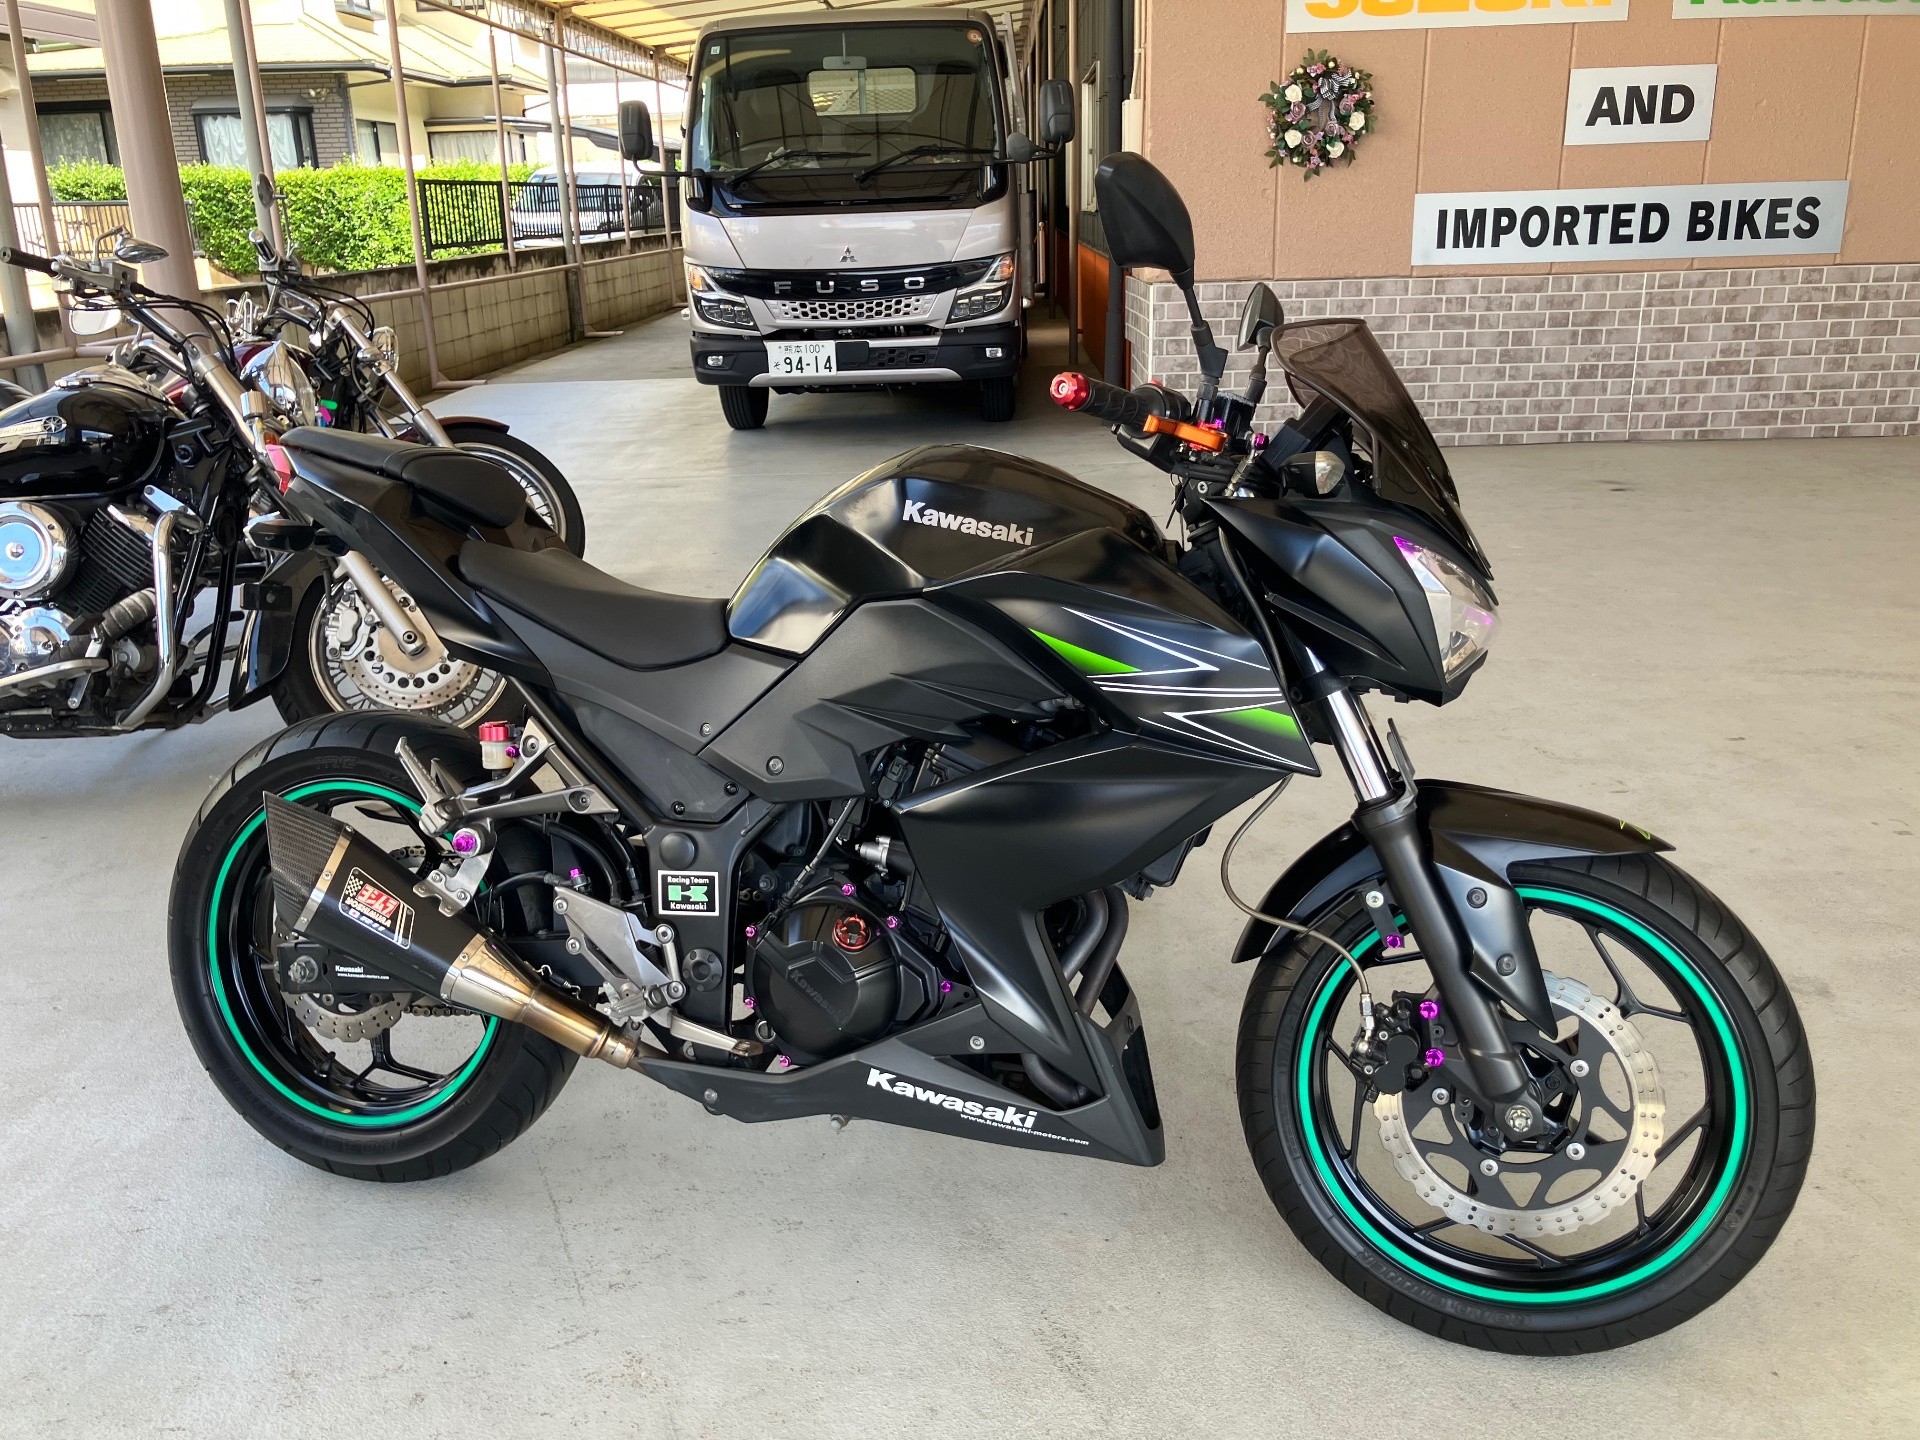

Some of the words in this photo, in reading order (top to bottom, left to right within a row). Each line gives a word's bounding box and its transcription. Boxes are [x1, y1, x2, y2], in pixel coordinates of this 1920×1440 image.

[1585, 84, 1695, 126] AND
[1436, 202, 1670, 250] IMPORTED
[1687, 196, 1822, 242] BIKES
[774, 276, 925, 294] FUSO
[784, 355, 832, 373] 94-14
[903, 500, 1034, 546] Kawasaki
[667, 875, 690, 885] Racing
[690, 876, 709, 884] Team
[670, 902, 707, 910] Kawasaki
[866, 1068, 1037, 1128] Kawasaki
[960, 1113, 1090, 1146] www.kawasaki-motors.com
